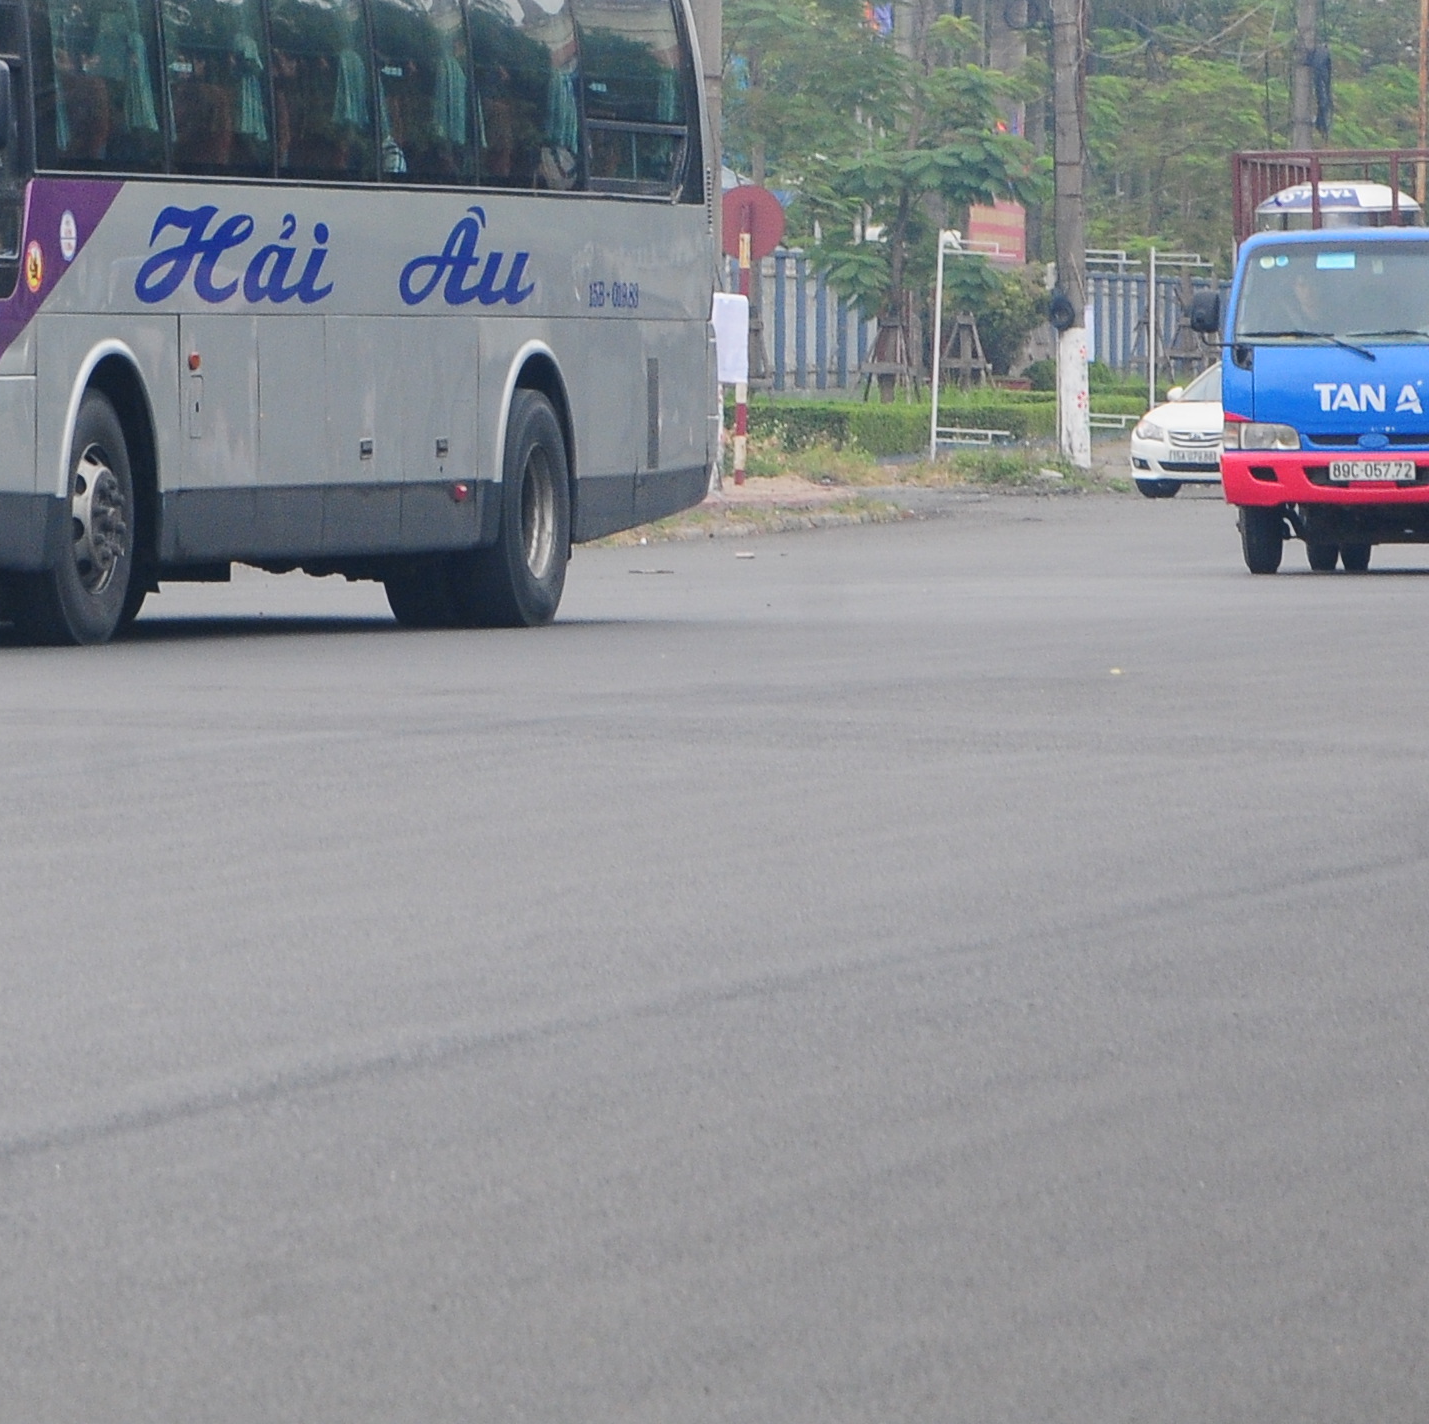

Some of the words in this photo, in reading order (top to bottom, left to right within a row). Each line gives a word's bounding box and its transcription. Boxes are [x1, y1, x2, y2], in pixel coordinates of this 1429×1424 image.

[135, 205, 334, 304] Hải
[1313, 383, 1385, 412] TAN
[1332, 463, 1413, 479] 89C-057.72
